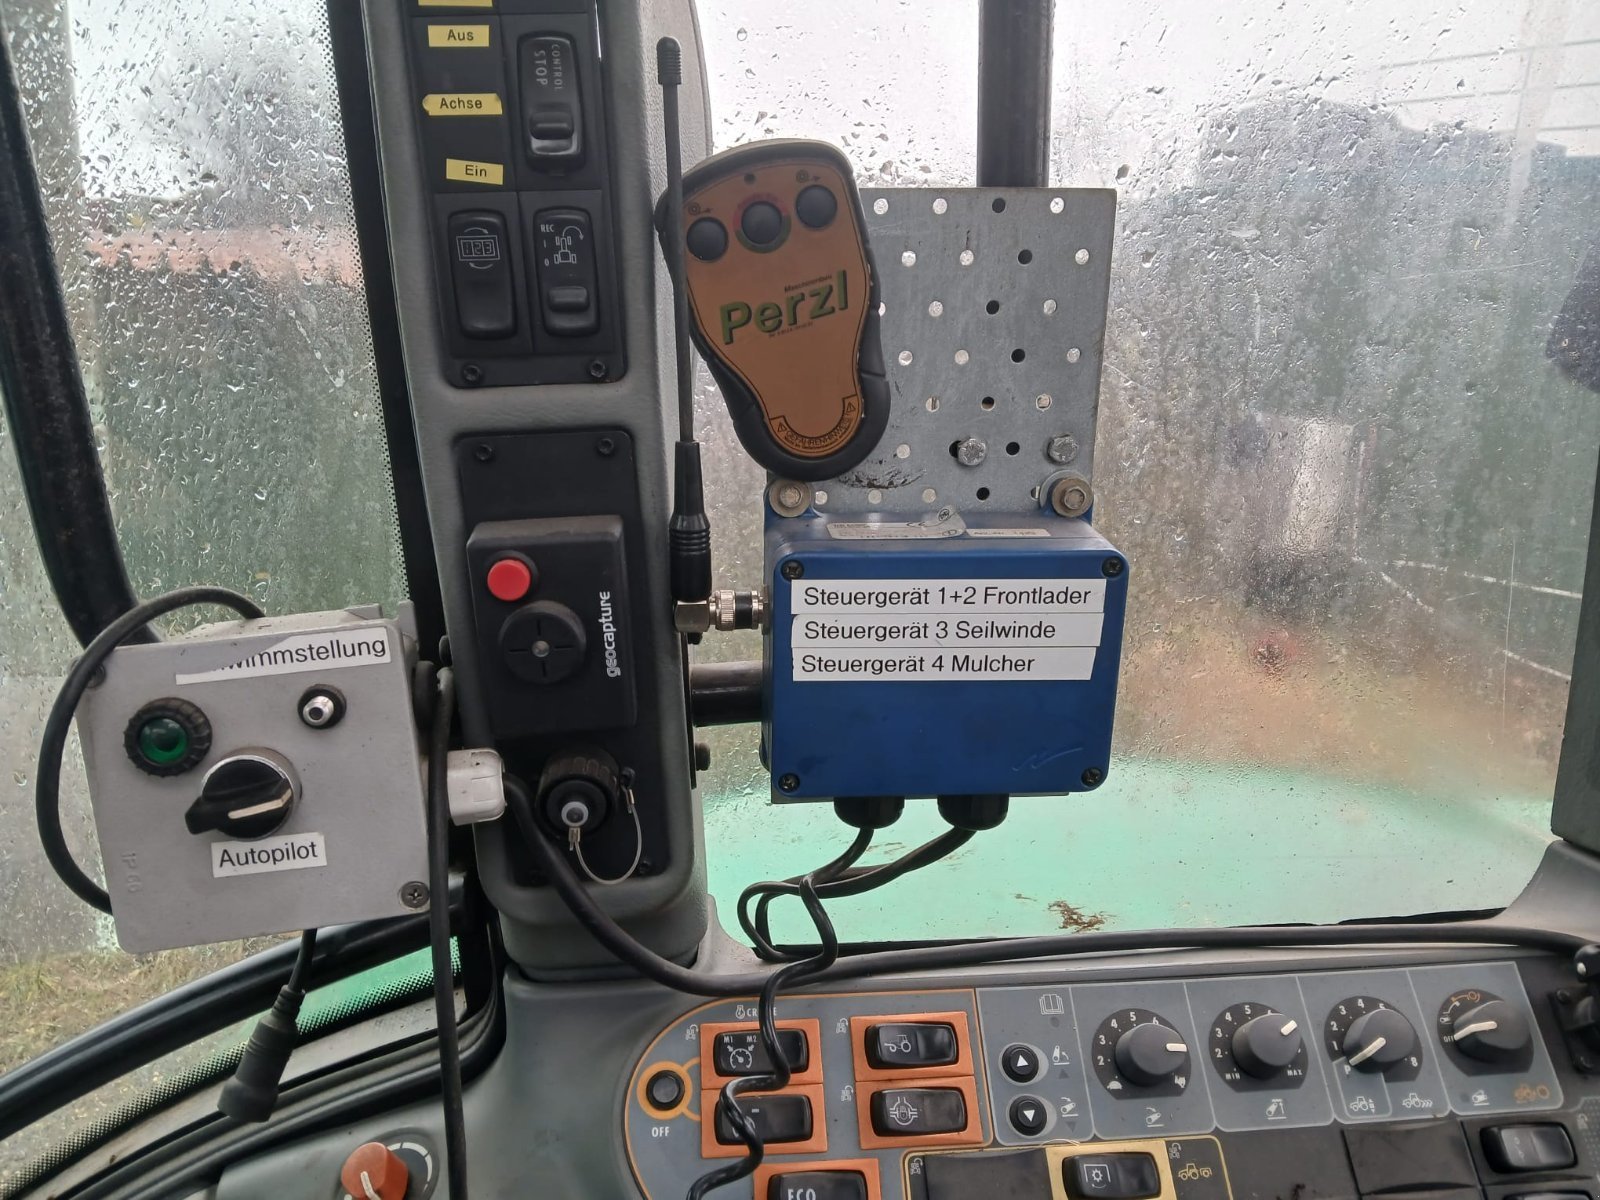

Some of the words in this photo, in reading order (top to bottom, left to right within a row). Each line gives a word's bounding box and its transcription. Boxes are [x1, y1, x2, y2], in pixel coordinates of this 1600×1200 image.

[447, 29, 474, 42] Aus
[535, 51, 548, 85] STOP
[439, 97, 483, 110] Achse
[465, 164, 488, 178] Ein
[540, 223, 554, 233] REC
[720, 269, 848, 345] Perzl
[804, 586, 930, 608] Steuergerät
[938, 586, 977, 605] 1+2
[983, 586, 1092, 605] Frontlader
[598, 590, 622, 678] geocapture
[804, 619, 929, 642] Steuergerät
[935, 620, 949, 639] 3
[955, 620, 1056, 639] Seilwinde
[801, 654, 925, 676] Steuergerät
[931, 654, 945, 672] 4
[951, 654, 1035, 673] Mulcher
[219, 841, 319, 868] Autopilot
[1357, 998, 1365, 1009] 4
[1244, 1005, 1252, 1015] 5
[1338, 1005, 1347, 1016] 3
[1129, 1012, 1137, 1021] 5
[1225, 1012, 1232, 1022] 4
[1110, 1018, 1118, 1029] 4
[1330, 1021, 1339, 1032] 2
[1215, 1027, 1223, 1038] 3
[723, 1035, 734, 1043] M1
[746, 1035, 757, 1043] M2
[1098, 1035, 1106, 1045] 3
[1332, 1041, 1339, 1051] 1
[1214, 1048, 1223, 1058] 2
[1097, 1055, 1105, 1066] 2
[1410, 1056, 1418, 1067] 8
[1225, 1072, 1241, 1080] MIN
[1287, 1069, 1303, 1077] MAX
[651, 1126, 670, 1138] OFF
